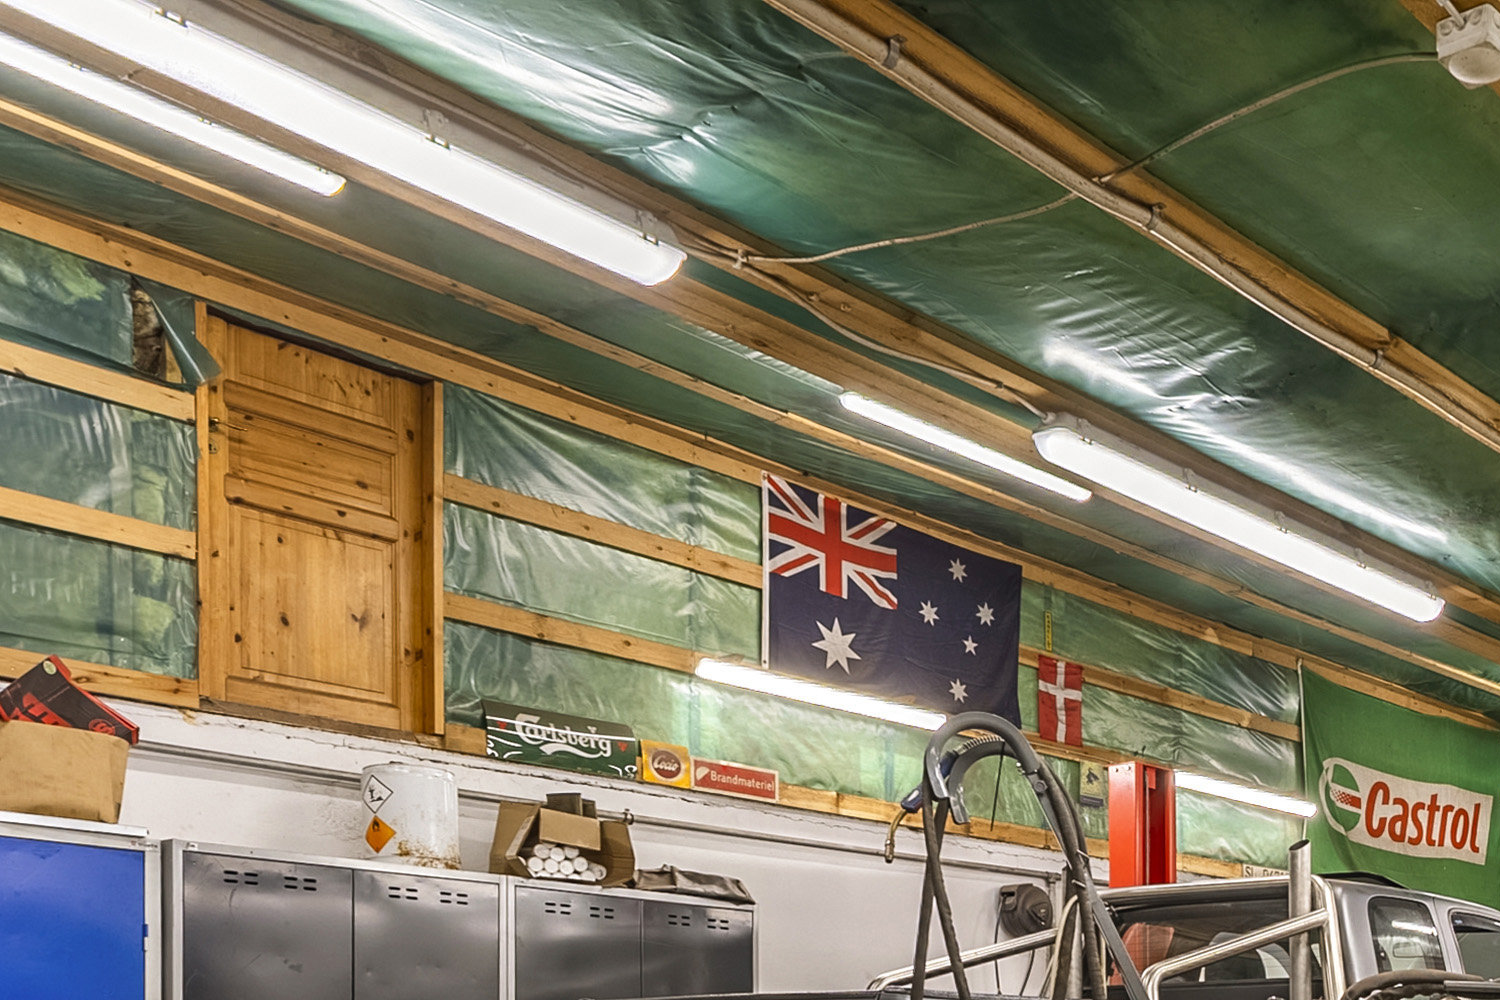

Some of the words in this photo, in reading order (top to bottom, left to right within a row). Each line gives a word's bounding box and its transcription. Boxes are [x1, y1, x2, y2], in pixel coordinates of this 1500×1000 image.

[514, 713, 612, 757] Carlsberg
[653, 754, 678, 772] Cocio
[709, 769, 776, 792] Brandmateriel
[1365, 781, 1481, 853] Castrol
